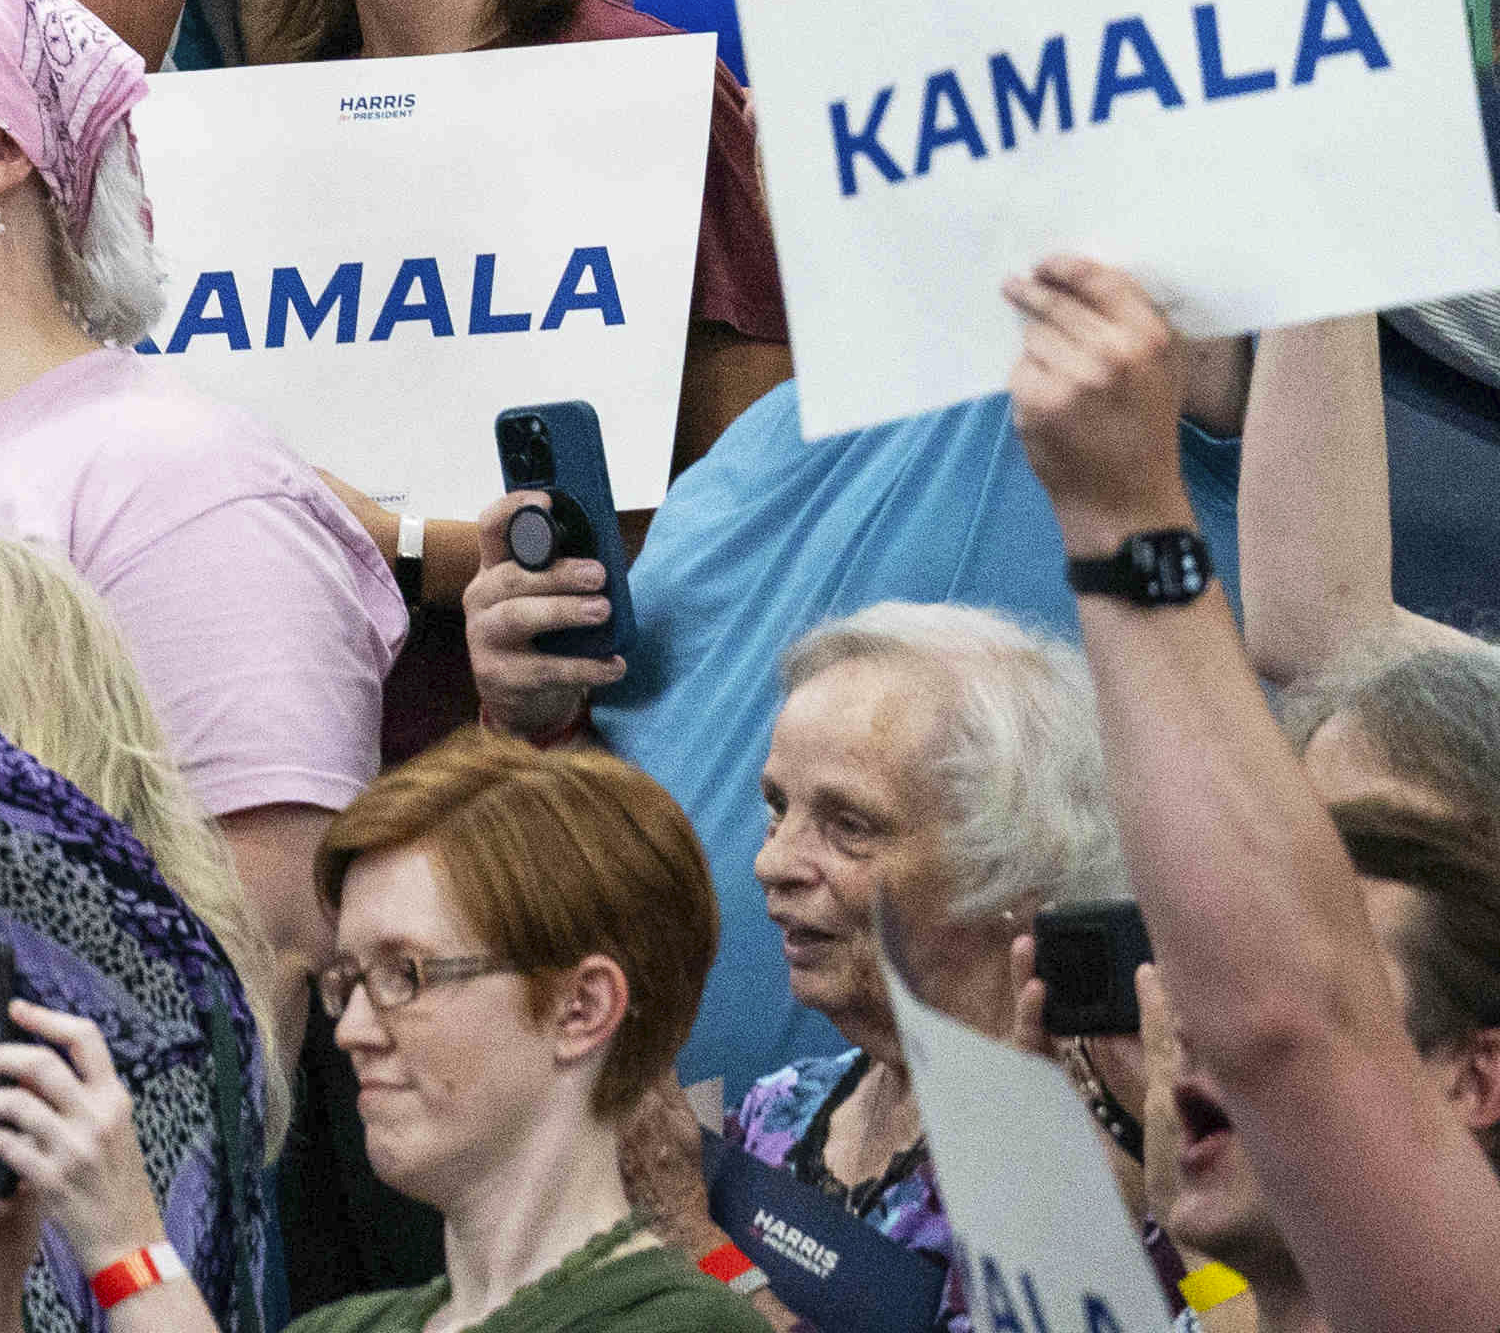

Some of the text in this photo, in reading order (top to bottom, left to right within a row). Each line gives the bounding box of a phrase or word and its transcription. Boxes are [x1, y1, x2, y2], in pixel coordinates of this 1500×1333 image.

[340, 94, 416, 111] HARRIS
[353, 109, 413, 120] PRESIDENT
[134, 245, 626, 356] AMALA
[754, 1209, 840, 1270] HARRIS
